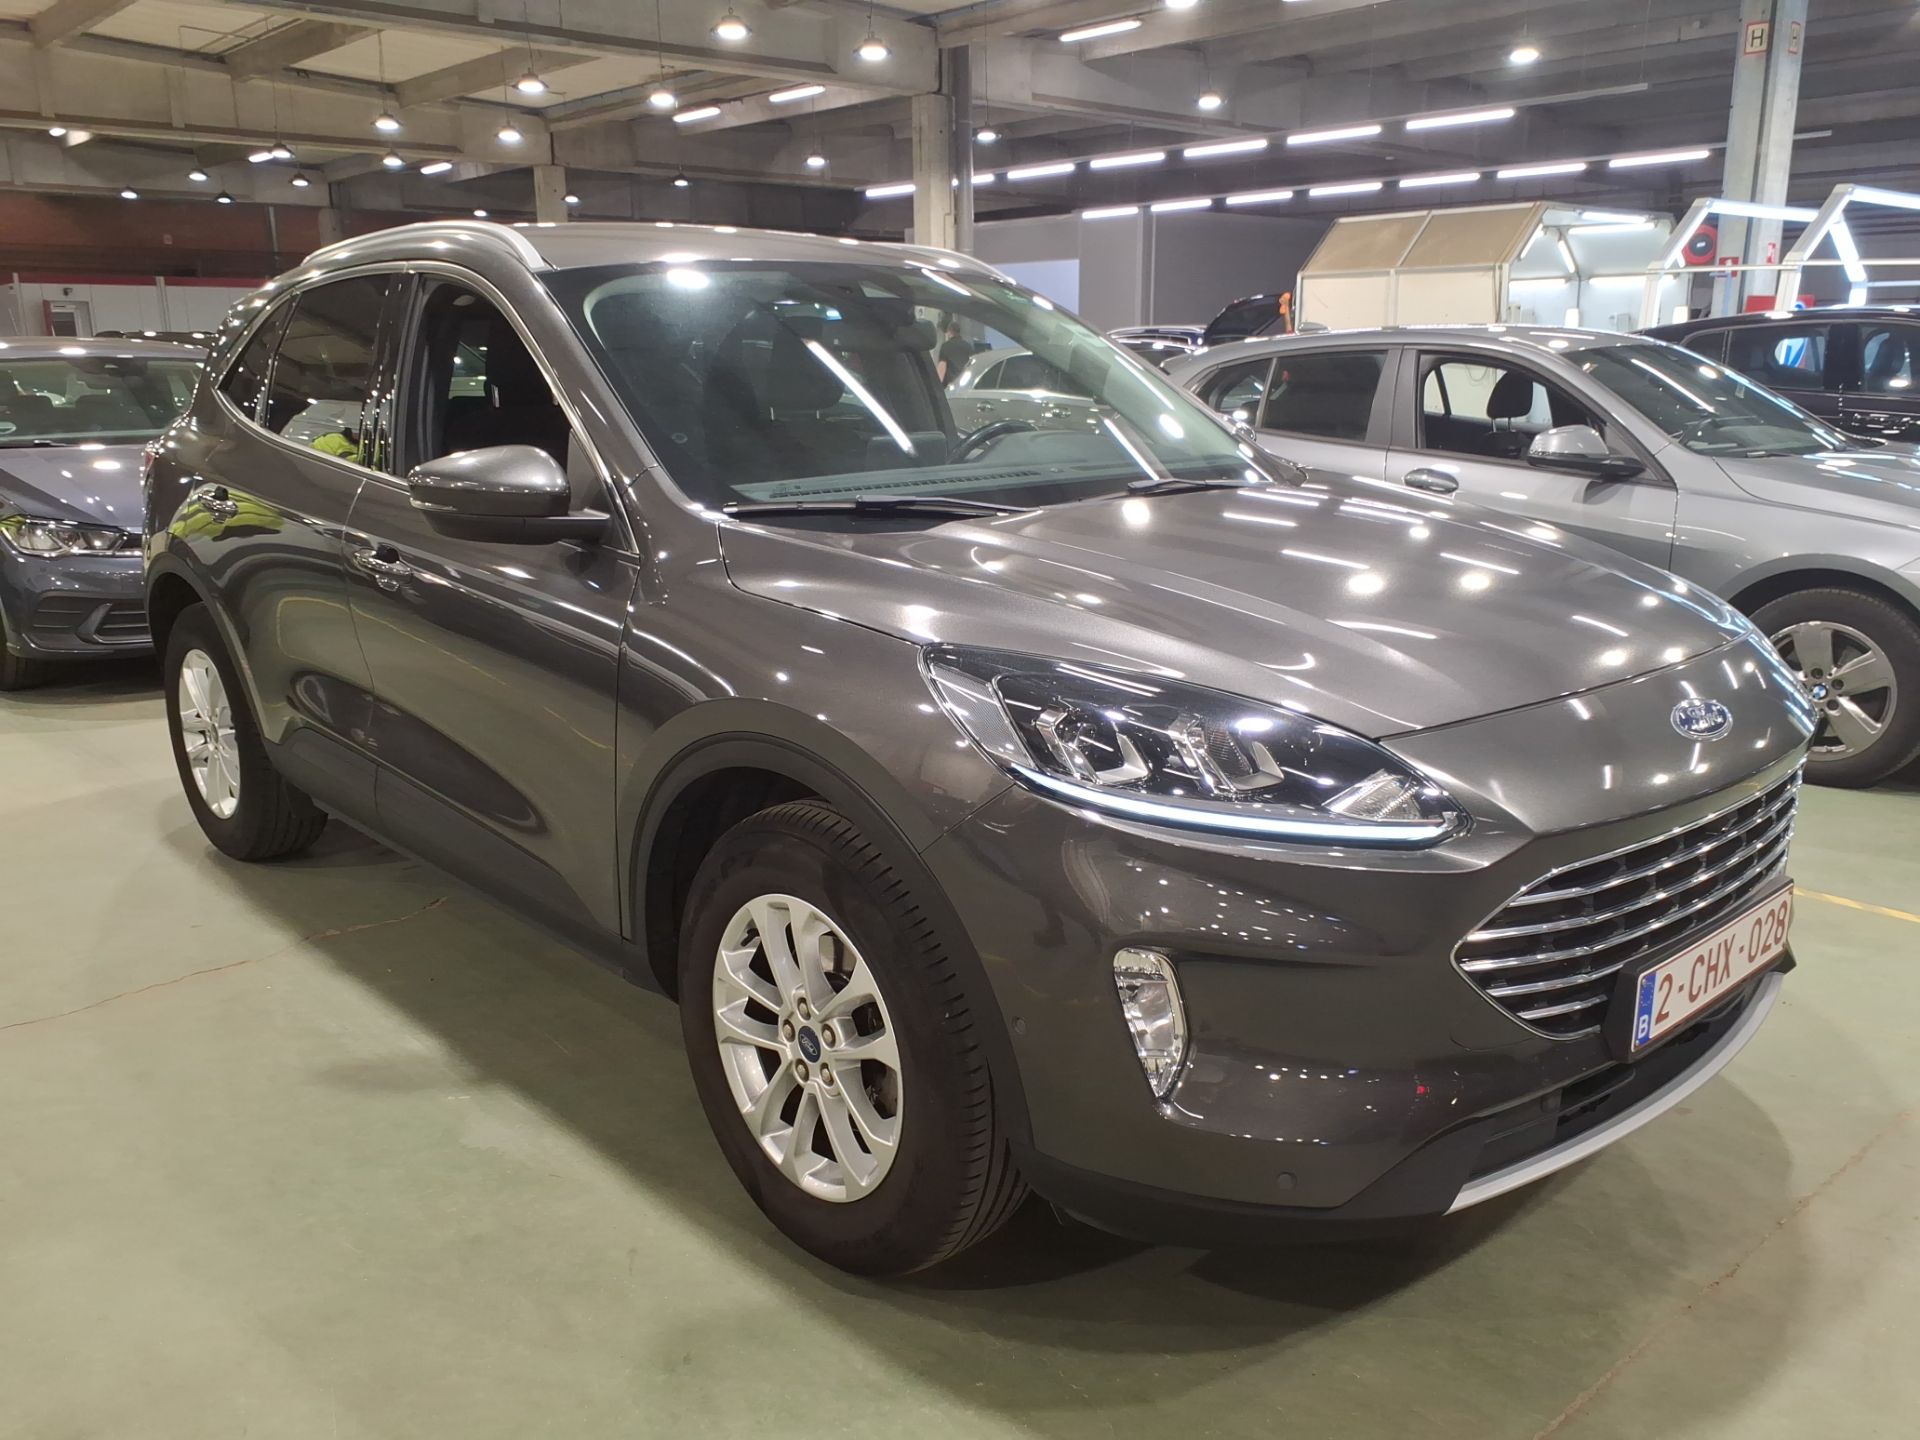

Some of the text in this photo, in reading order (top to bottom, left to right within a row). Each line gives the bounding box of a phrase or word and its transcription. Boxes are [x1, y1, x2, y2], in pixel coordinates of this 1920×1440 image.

[1750, 28, 1763, 48] H
[1654, 900, 1788, 1026] 2-CHX-028
[1637, 1014, 1649, 1039] B
